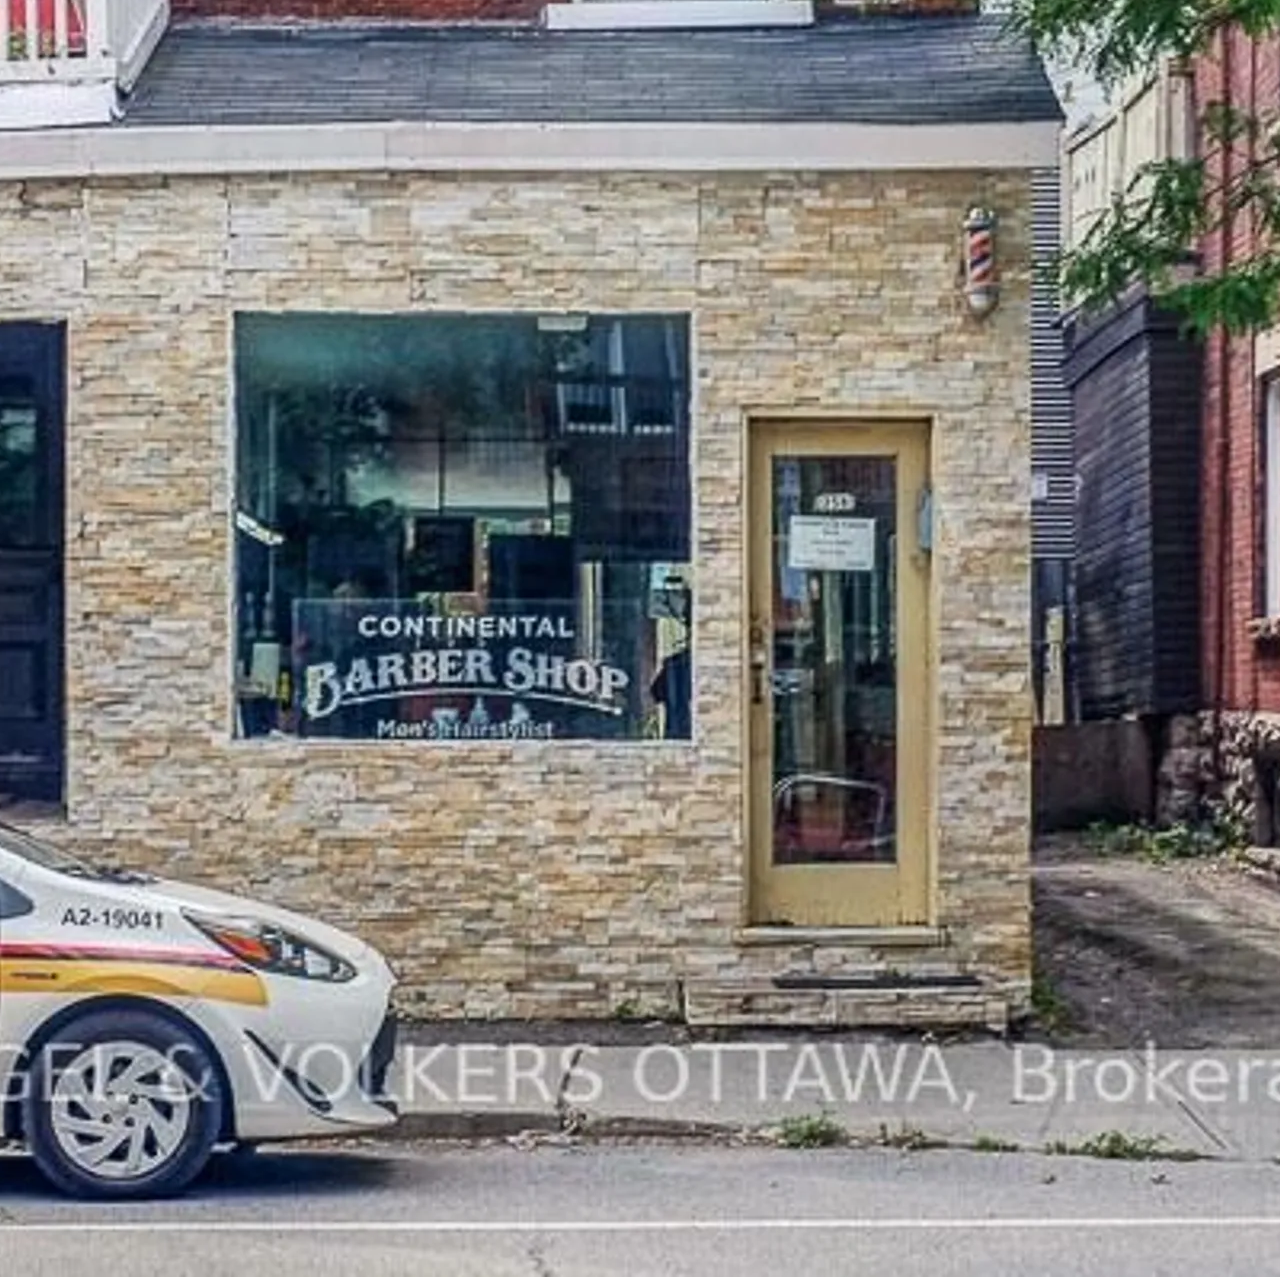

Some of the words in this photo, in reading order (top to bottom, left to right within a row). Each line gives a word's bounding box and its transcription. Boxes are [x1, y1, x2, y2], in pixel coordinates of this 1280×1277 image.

[357, 616, 574, 639] CONTINENTAL
[305, 648, 496, 719] BARBER
[503, 646, 629, 699] SHOP
